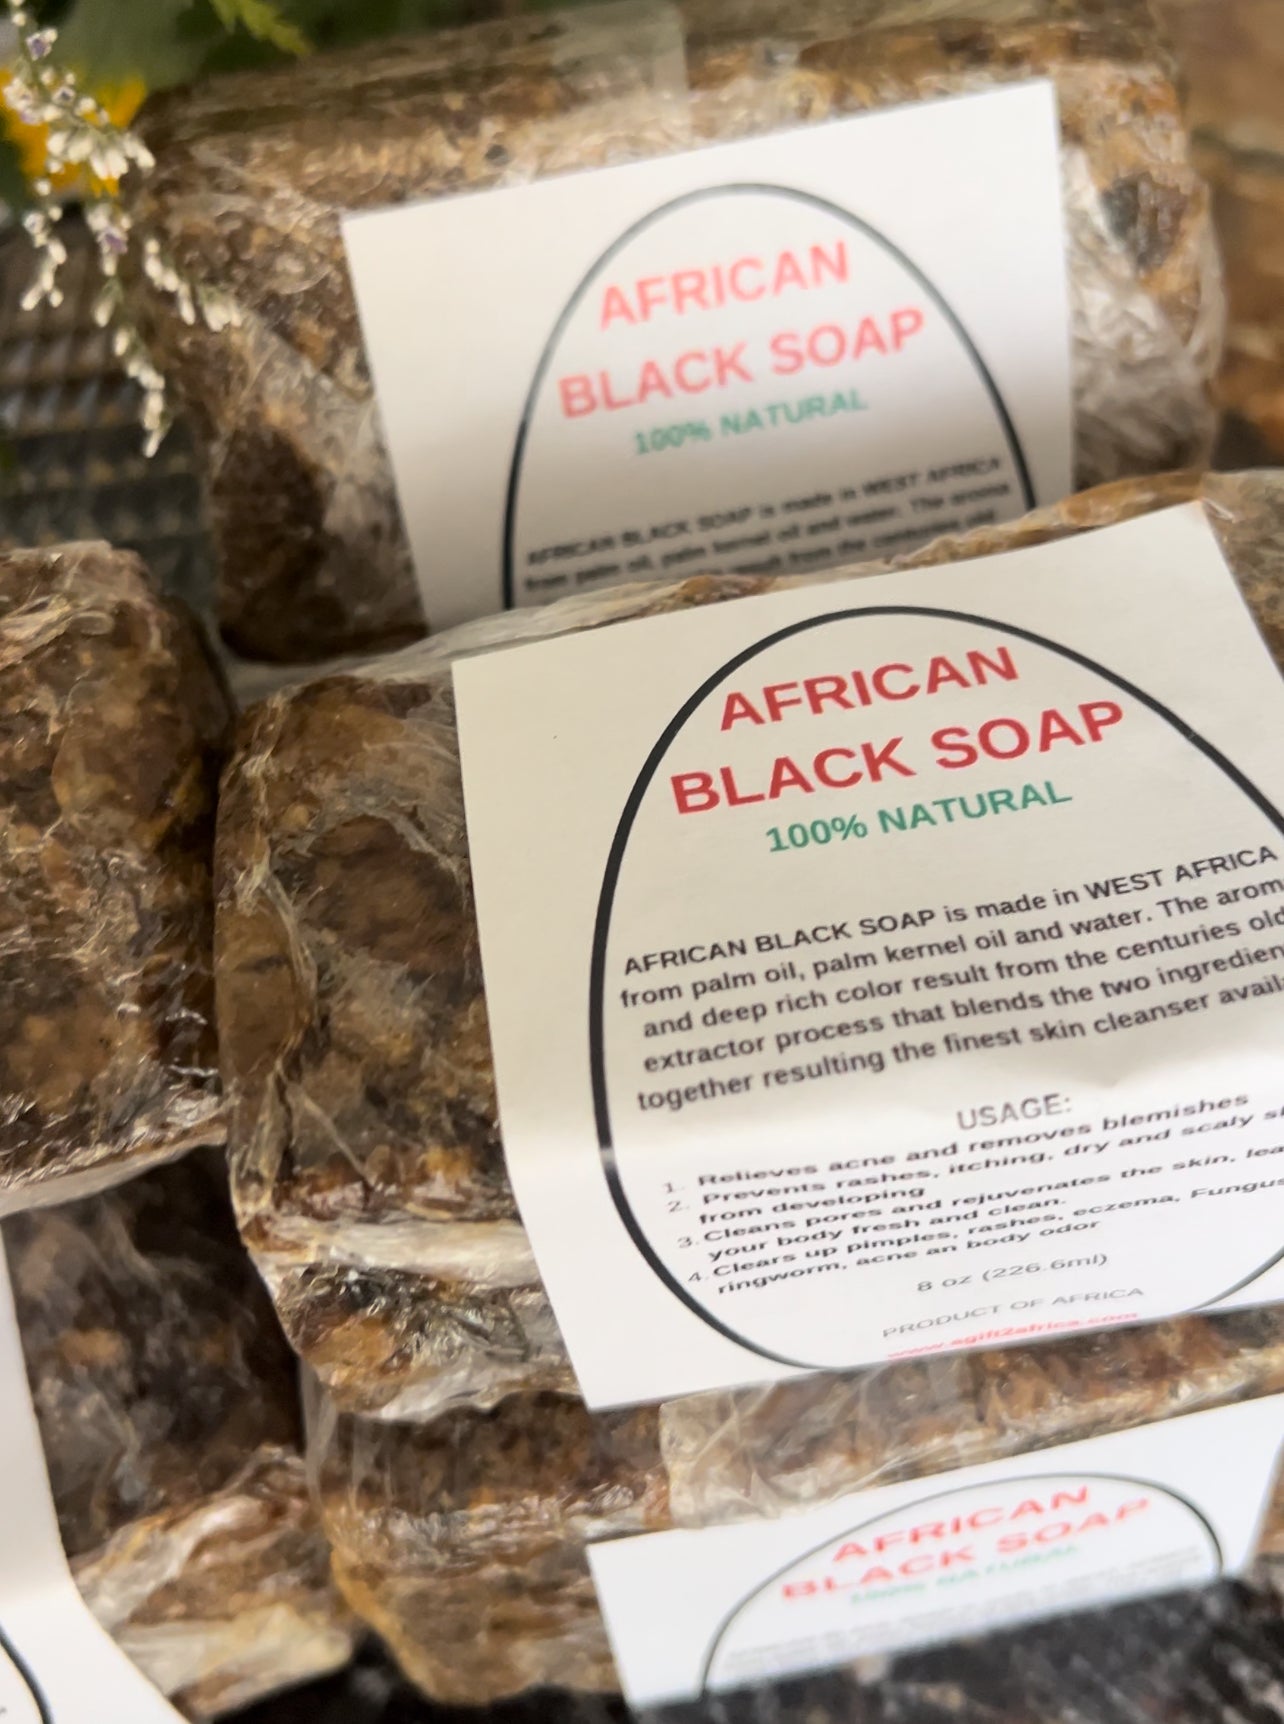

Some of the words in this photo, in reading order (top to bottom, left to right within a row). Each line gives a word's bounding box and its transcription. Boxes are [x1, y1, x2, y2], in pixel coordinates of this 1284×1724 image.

[600, 240, 851, 331] AFRICAN
[558, 342, 754, 419] BLACK
[768, 306, 924, 377] SOAP
[633, 418, 711, 455] 100%
[720, 388, 868, 438] NATURAL
[528, 536, 614, 565] AFRICAN
[621, 521, 691, 546] BLACK
[697, 506, 751, 531] SOAP
[781, 493, 832, 513] made
[861, 472, 921, 496] WEST
[928, 458, 1000, 482] AFRICA
[719, 645, 1020, 731] AFRICAN
[670, 737, 917, 815] BLACK
[931, 700, 1124, 770] SOAP
[765, 813, 868, 853] 100%
[878, 779, 1073, 834] NATURAL
[620, 985, 682, 1008] from
[691, 971, 756, 1000] palm
[765, 962, 805, 983] oil,
[813, 951, 877, 979] palm
[884, 934, 966, 962] kernel
[975, 929, 1007, 951] oil
[1015, 921, 1064, 945] and
[1070, 907, 1152, 936] water.
[1157, 896, 1208, 918] The
[624, 939, 746, 975] AFRICAN
[755, 922, 853, 952] BLACK
[859, 909, 935, 935] SOAP
[944, 905, 967, 923] is
[975, 894, 1047, 919] made
[1053, 888, 1079, 907] in
[1083, 869, 1163, 901] WEST
[1175, 846, 1278, 882] AFRICA
[643, 1012, 692, 1038] and
[701, 1001, 767, 1028] deep
[776, 989, 828, 1014] rich
[835, 978, 903, 1004] color
[912, 966, 990, 991] result
[995, 957, 1059, 980] from
[1065, 946, 1108, 971] the
[1116, 922, 1241, 960] centuries
[1248, 907, 1284, 932] old
[637, 1073, 753, 1111] together
[763, 1050, 885, 1087] resulting
[891, 1041, 937, 1064] the
[942, 1027, 1022, 1053] finest
[1029, 1021, 1087, 1042] skin
[1093, 994, 1210, 1034] cleanser
[1217, 973, 1284, 1006] avail
[643, 1035, 765, 1072] extractor
[775, 1014, 884, 1054] process
[891, 1004, 945, 1028] that
[952, 991, 1044, 1019] blends
[1051, 984, 1094, 1007] the
[1100, 976, 1151, 998] two
[697, 1164, 818, 1186] Relieves
[828, 1153, 896, 1171] acne
[905, 1142, 958, 1162] and
[969, 1123, 1093, 1152] removes
[1101, 1093, 1250, 1131] blemishes
[956, 1092, 1072, 1130] USAGE:
[702, 1182, 826, 1205] Prevents
[835, 1166, 939, 1189] rashes,
[948, 1150, 1054, 1175] itching,
[1064, 1138, 1110, 1157] dry
[1118, 1129, 1171, 1147] and
[1180, 1113, 1254, 1137] scaly
[704, 1220, 796, 1242] Cleans
[805, 1207, 883, 1226] pores
[891, 1198, 942, 1215] and
[952, 1173, 1110, 1207] rejuvenates
[1121, 1165, 1163, 1180] the
[1172, 1153, 1236, 1171] skin,
[699, 1206, 763, 1225] from
[772, 1187, 926, 1214] developing
[707, 1241, 769, 1262] your
[777, 1229, 843, 1247] body
[852, 1218, 920, 1235] fresh
[929, 1210, 978, 1225] and
[988, 1198, 1067, 1217] clean.
[713, 1254, 797, 1277] Clears
[805, 1246, 838, 1259] up
[846, 1230, 959, 1254] pimples,
[968, 1216, 1064, 1235] rashes,
[1072, 1195, 1180, 1217] eczema,
[718, 1262, 848, 1294] ringworm,
[856, 1251, 918, 1266] acne
[926, 1244, 957, 1255] an
[967, 1233, 1031, 1250] body
[1039, 1220, 1101, 1237] odor
[917, 1281, 933, 1292] 8
[941, 1274, 972, 1288] oz
[982, 1253, 1108, 1282] (226.6ml)
[882, 1304, 1001, 1338] PRODUCT
[1010, 1298, 1045, 1311] OF
[1051, 1288, 1144, 1305] AFRICA
[782, 1544, 976, 1601] BLACK
[995, 1498, 1151, 1553] SOAP
[831, 1484, 1091, 1562] AFRICAN
